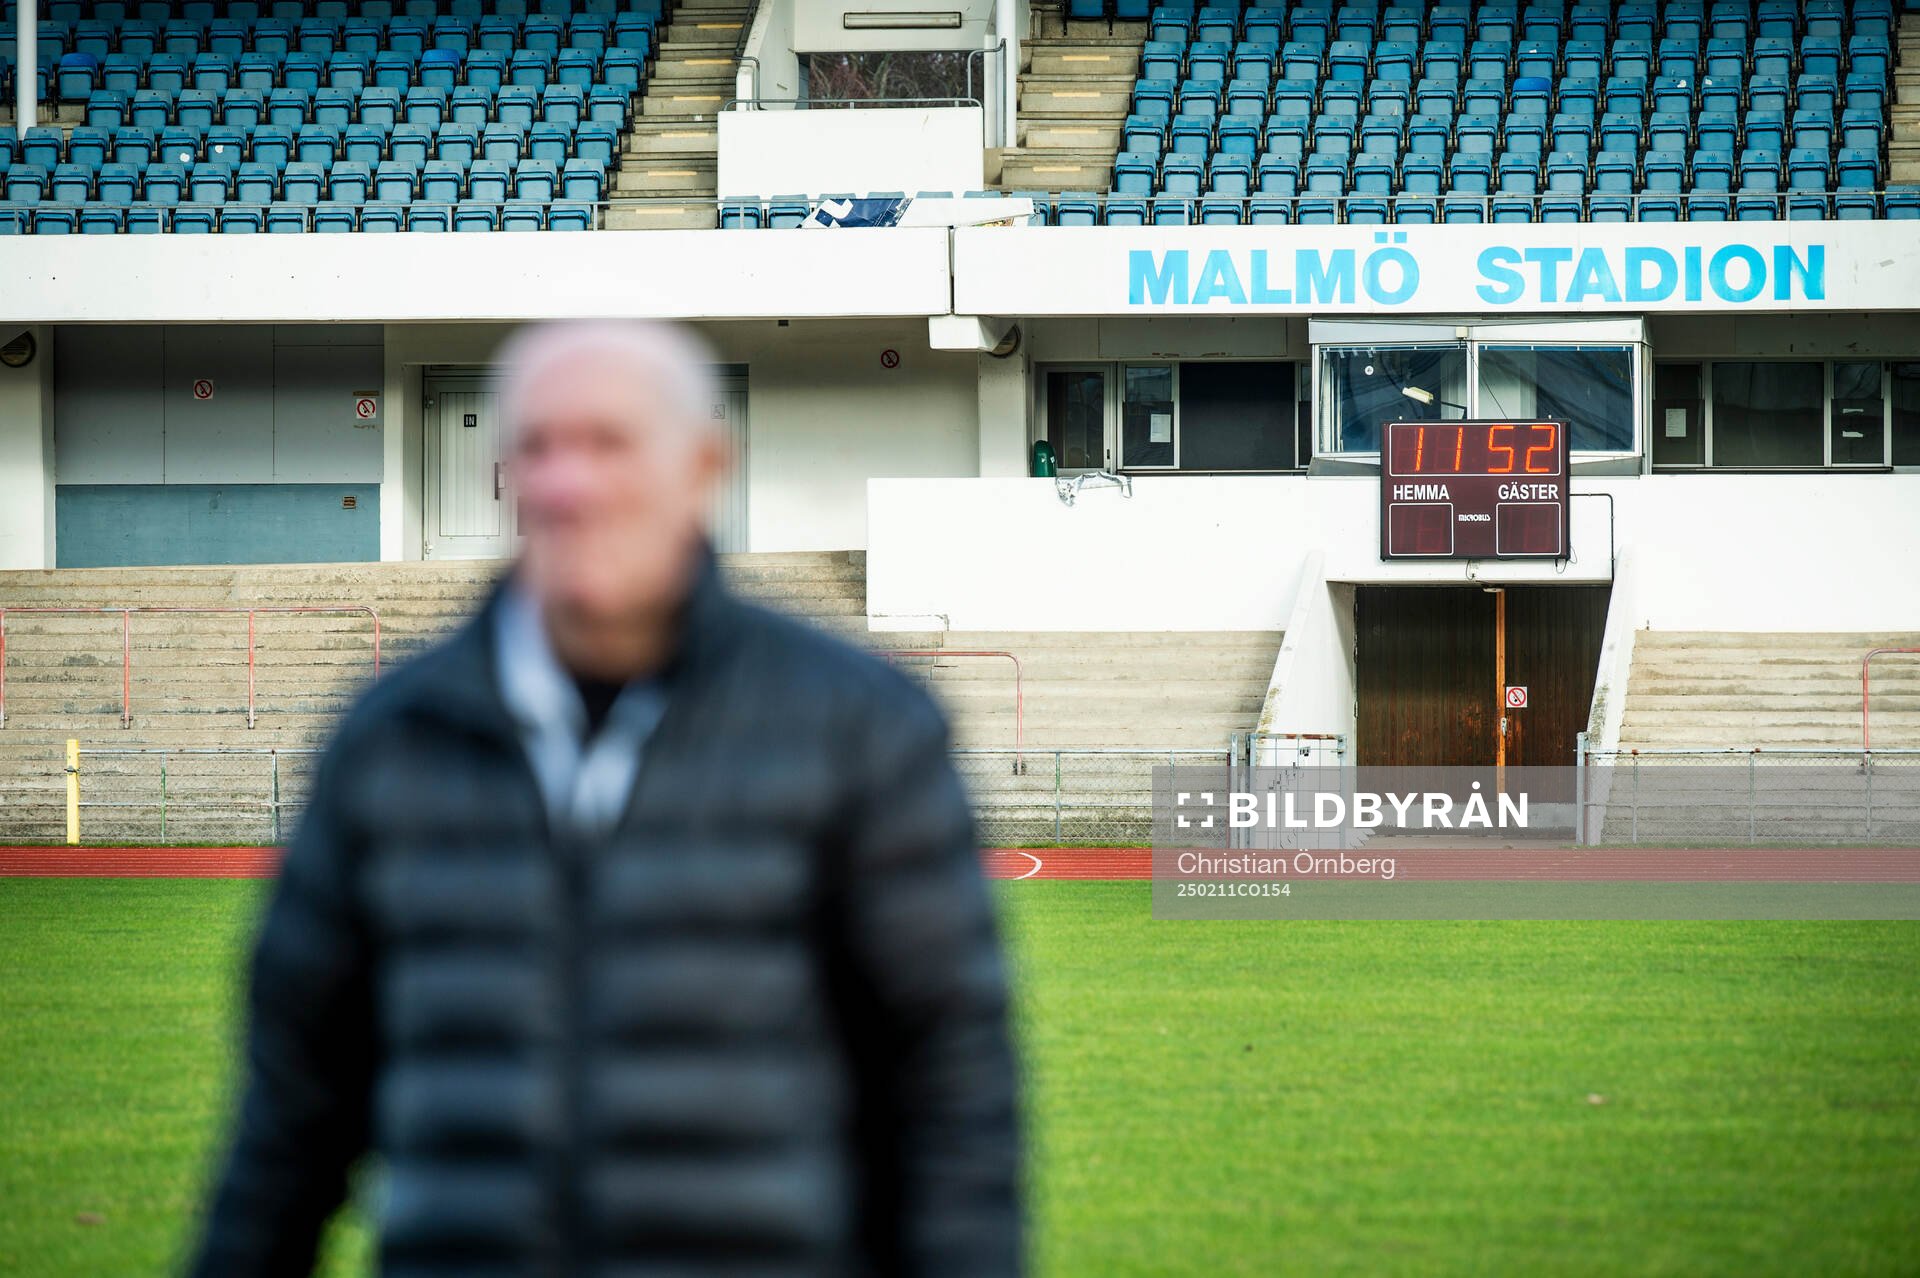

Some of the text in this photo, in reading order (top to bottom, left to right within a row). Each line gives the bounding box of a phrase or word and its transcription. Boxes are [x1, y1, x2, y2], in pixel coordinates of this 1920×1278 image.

[1129, 231, 1825, 305] MALMÖ STADION
[1393, 481, 1559, 500] HEMMA GÄSTER
